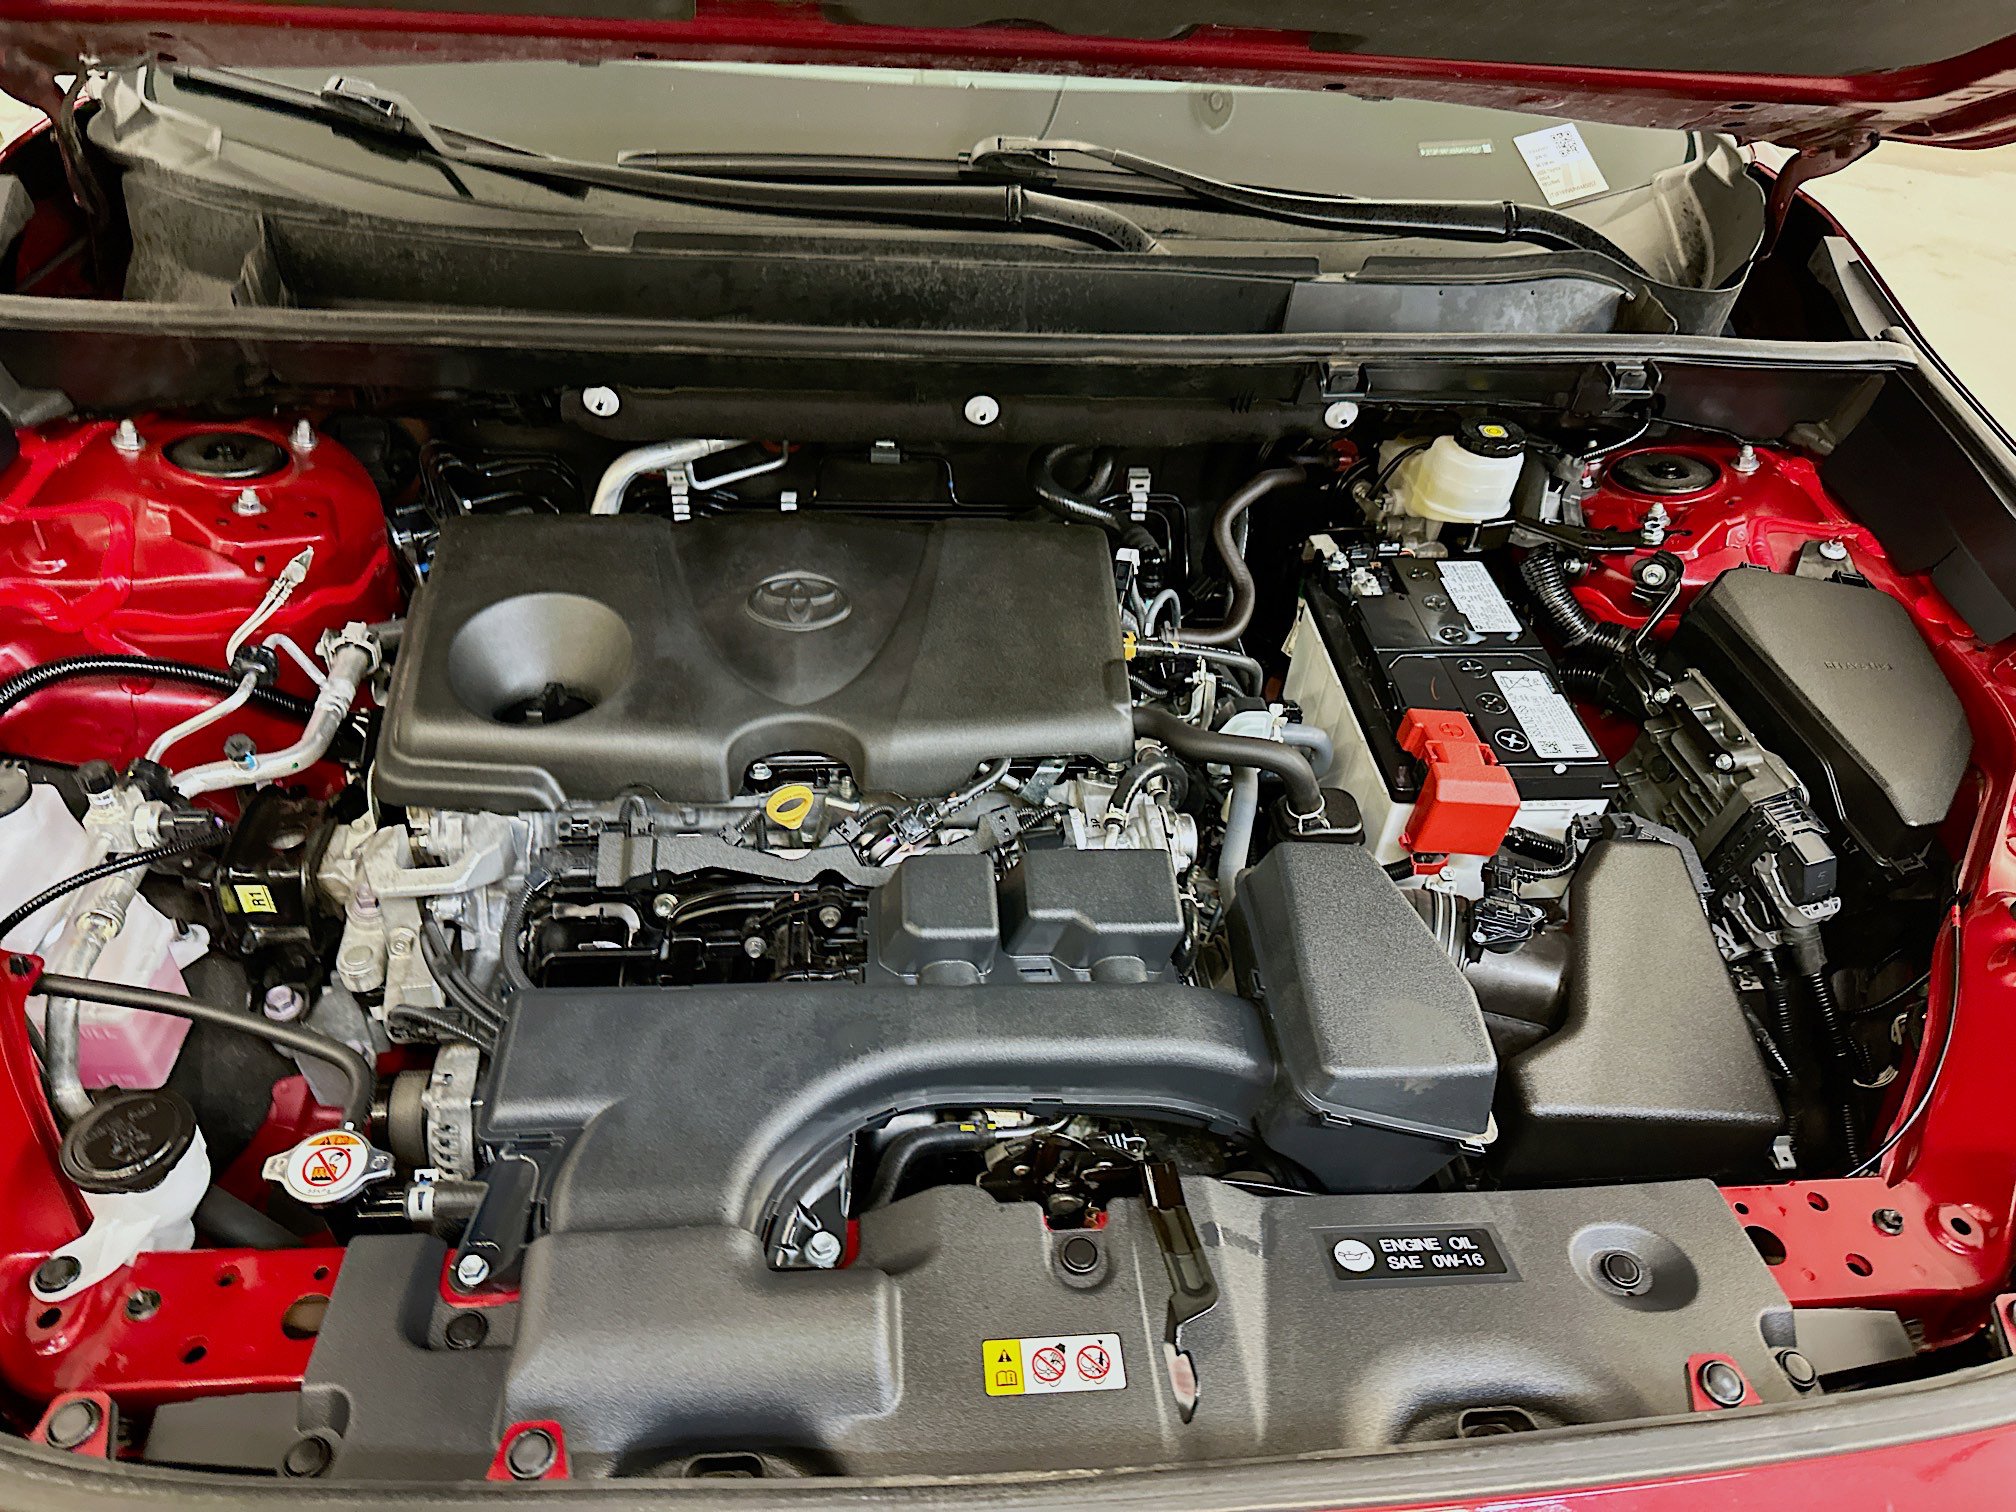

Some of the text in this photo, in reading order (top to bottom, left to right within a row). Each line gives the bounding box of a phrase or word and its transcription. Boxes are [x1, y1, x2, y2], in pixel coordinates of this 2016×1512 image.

[248, 892, 267, 907] R1
[1378, 1236, 1478, 1253] ENGINE OIL
[1386, 1253, 1485, 1270] SAE 0W-16
